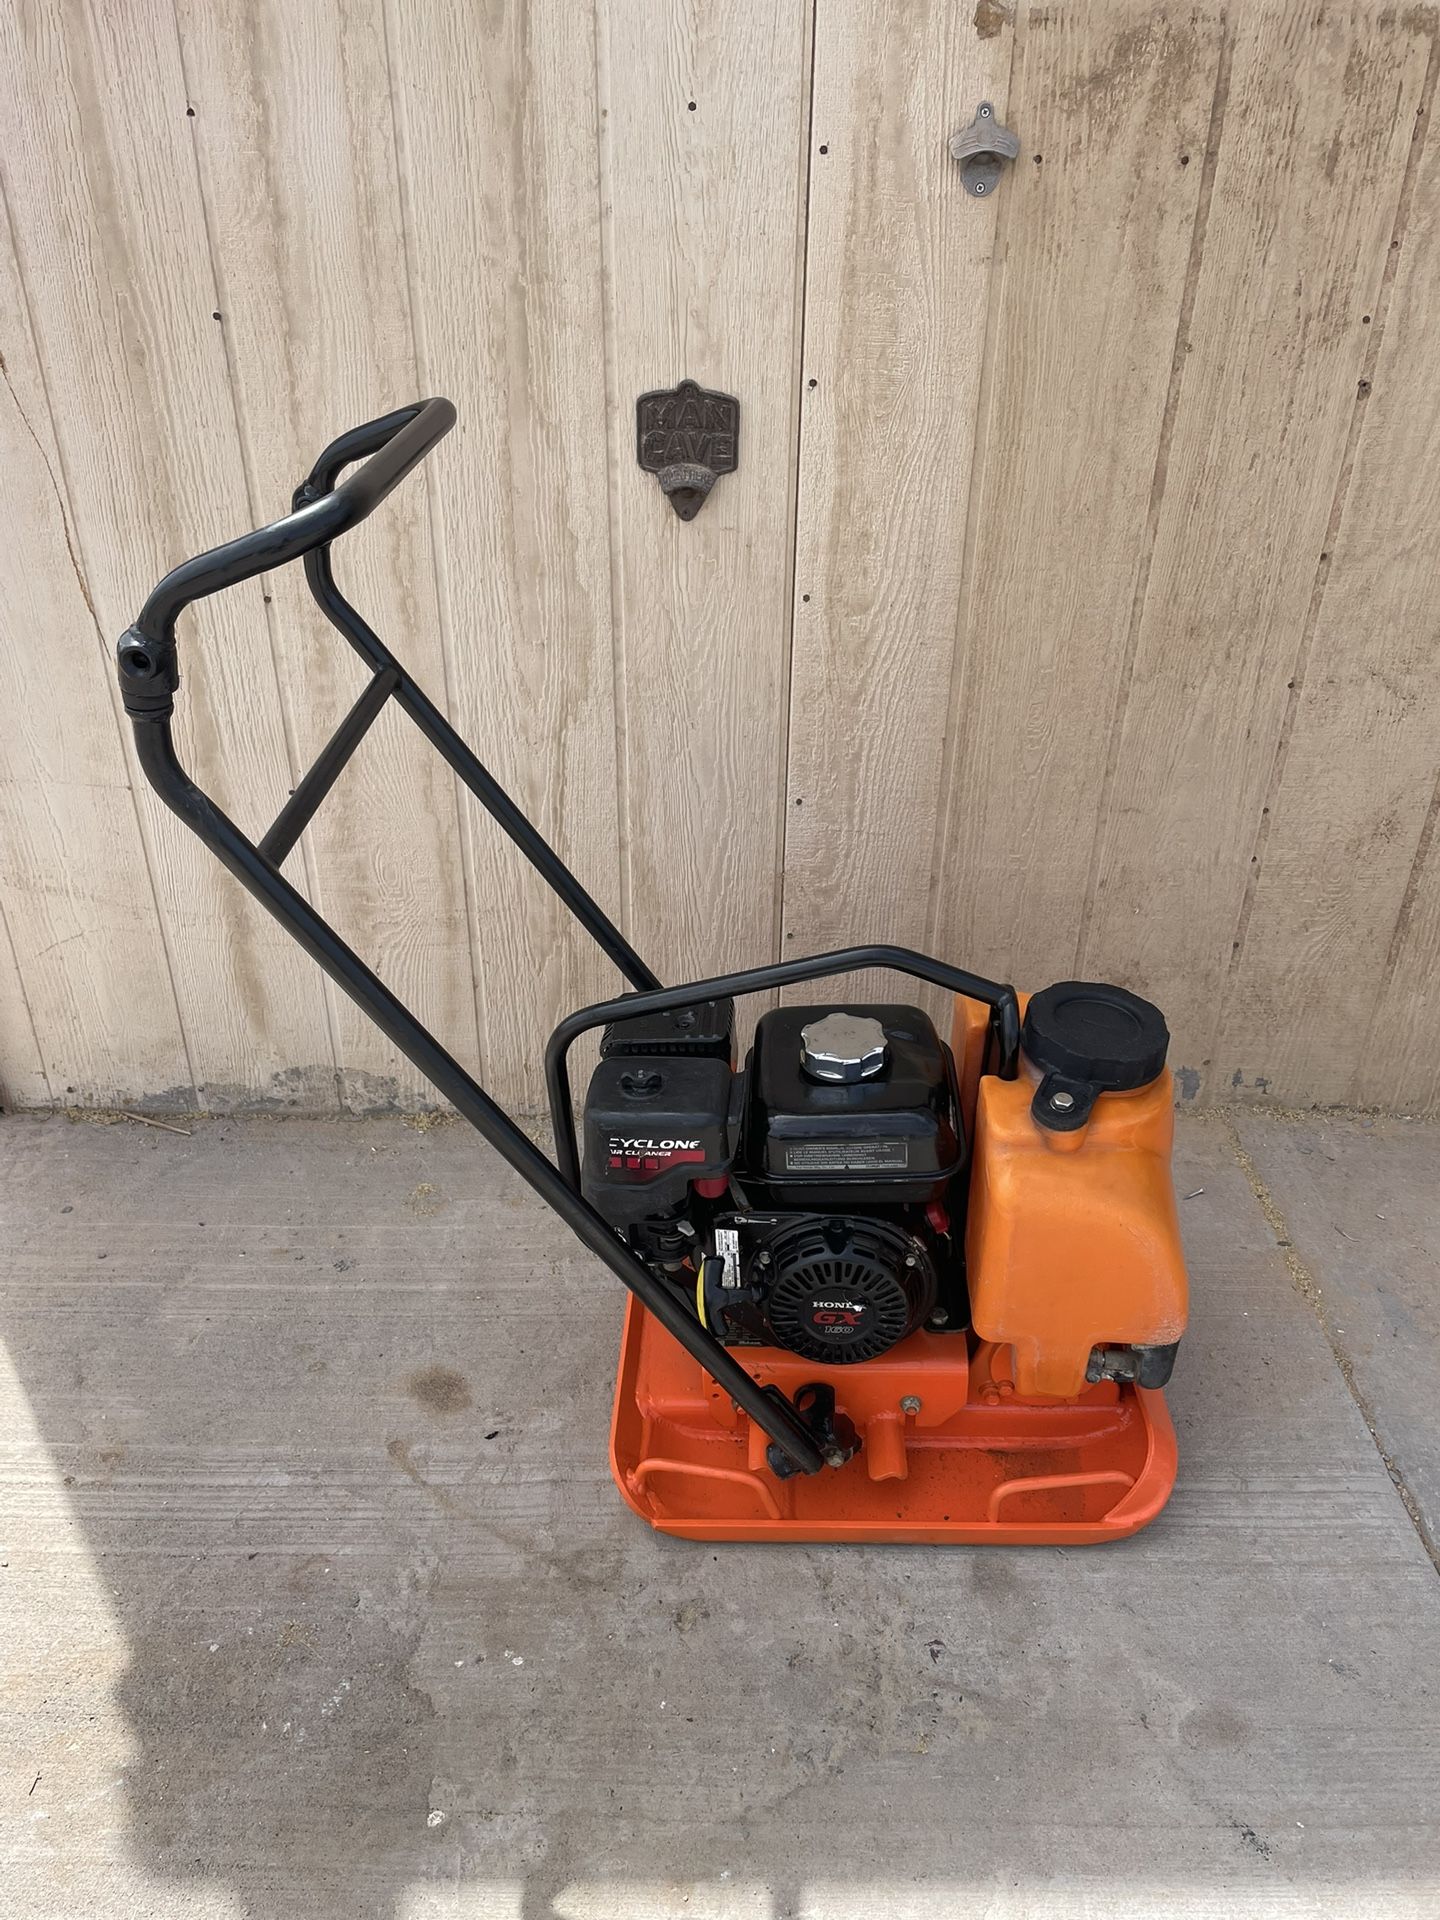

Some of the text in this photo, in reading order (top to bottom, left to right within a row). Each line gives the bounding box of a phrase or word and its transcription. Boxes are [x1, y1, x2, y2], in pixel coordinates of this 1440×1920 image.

[641, 399, 733, 430] MAN
[641, 430, 733, 461] CAVE
[812, 1301, 866, 1311] HON
[813, 1311, 865, 1326] GX
[824, 1325, 854, 1334] 160
